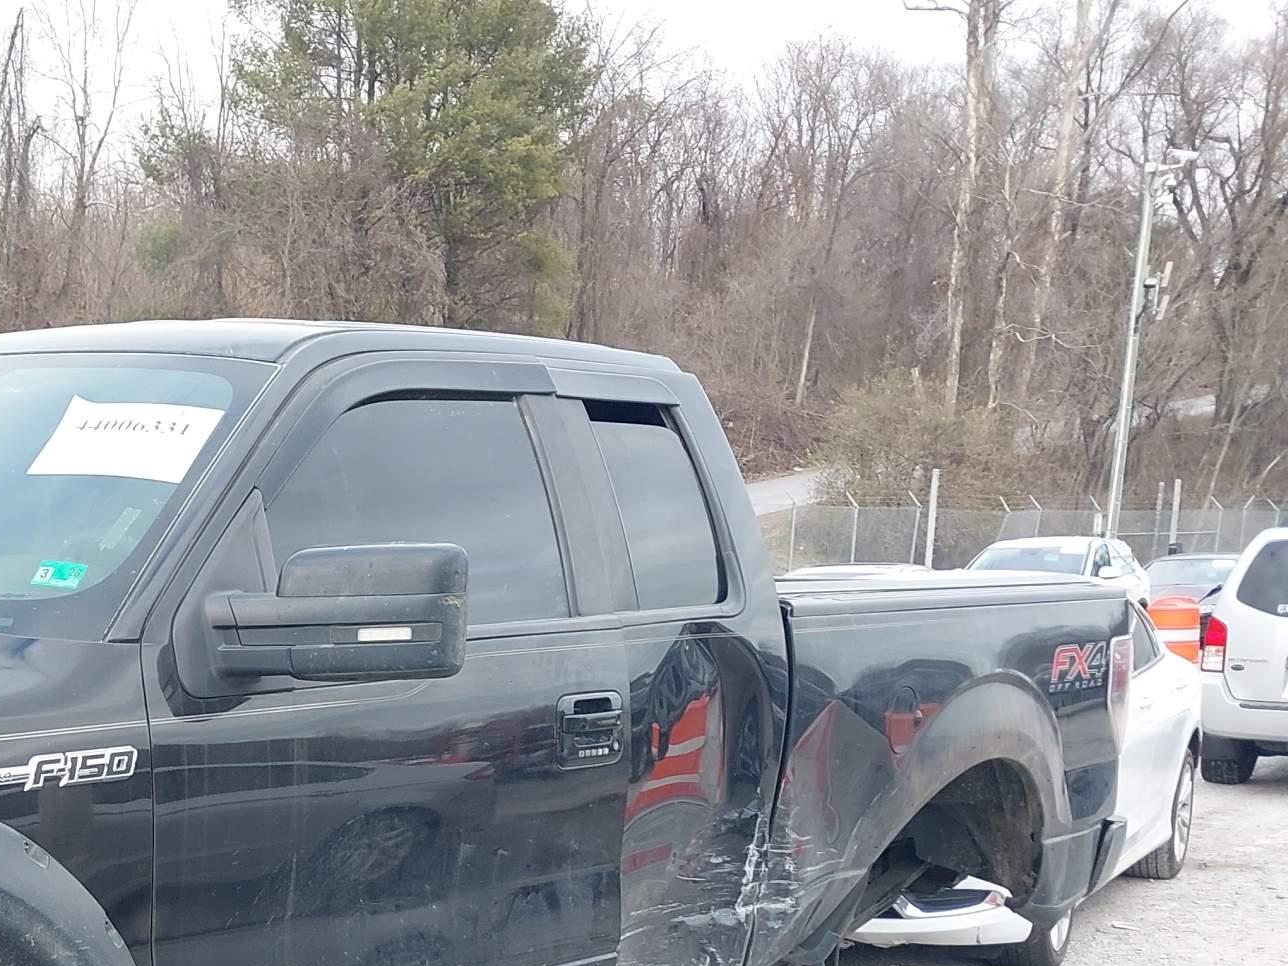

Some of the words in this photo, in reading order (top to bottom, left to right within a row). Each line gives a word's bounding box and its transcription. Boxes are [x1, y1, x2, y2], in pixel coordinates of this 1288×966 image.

[75, 419, 190, 436] 44006331
[40, 568, 50, 579] 3
[1050, 641, 1107, 683] FX4
[1049, 683, 1071, 693] OFF
[1074, 679, 1103, 689] ROAD
